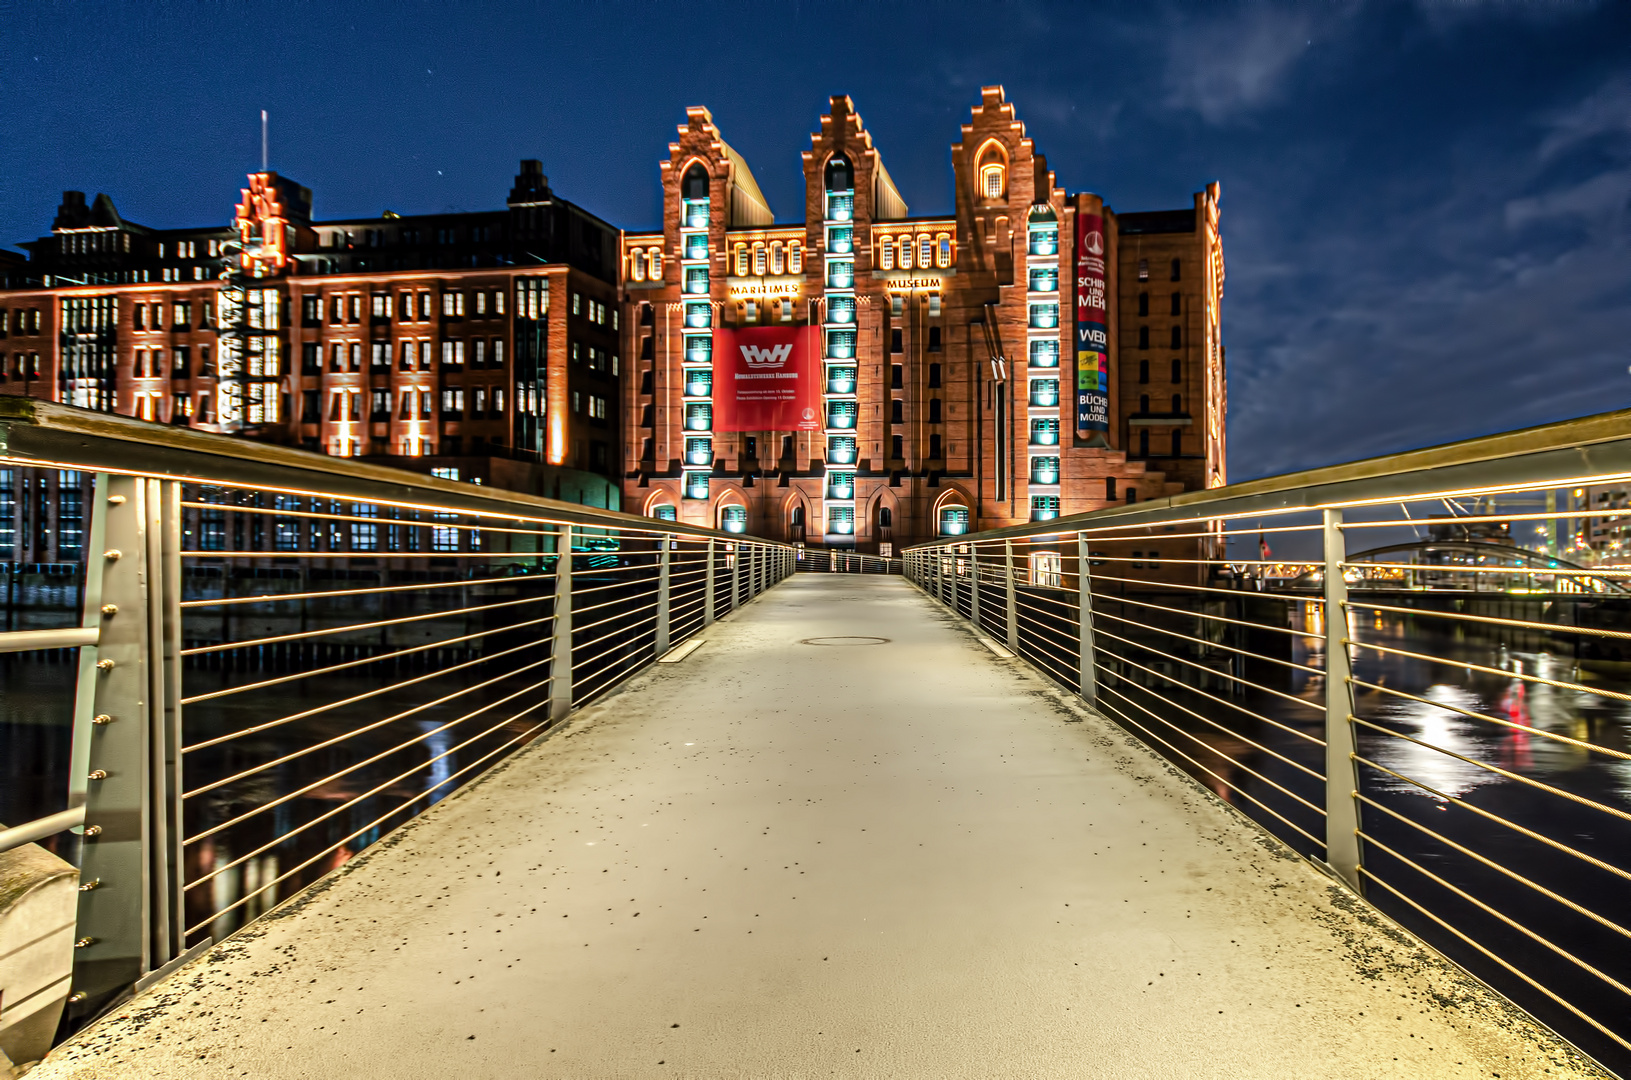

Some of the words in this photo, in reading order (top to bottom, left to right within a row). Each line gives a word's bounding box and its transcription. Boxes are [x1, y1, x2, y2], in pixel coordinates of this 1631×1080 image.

[887, 279, 940, 288] MUSEUM
[730, 284, 798, 295] MARITIMES
[1089, 287, 1104, 298] UND
[1090, 405, 1105, 414] UND
